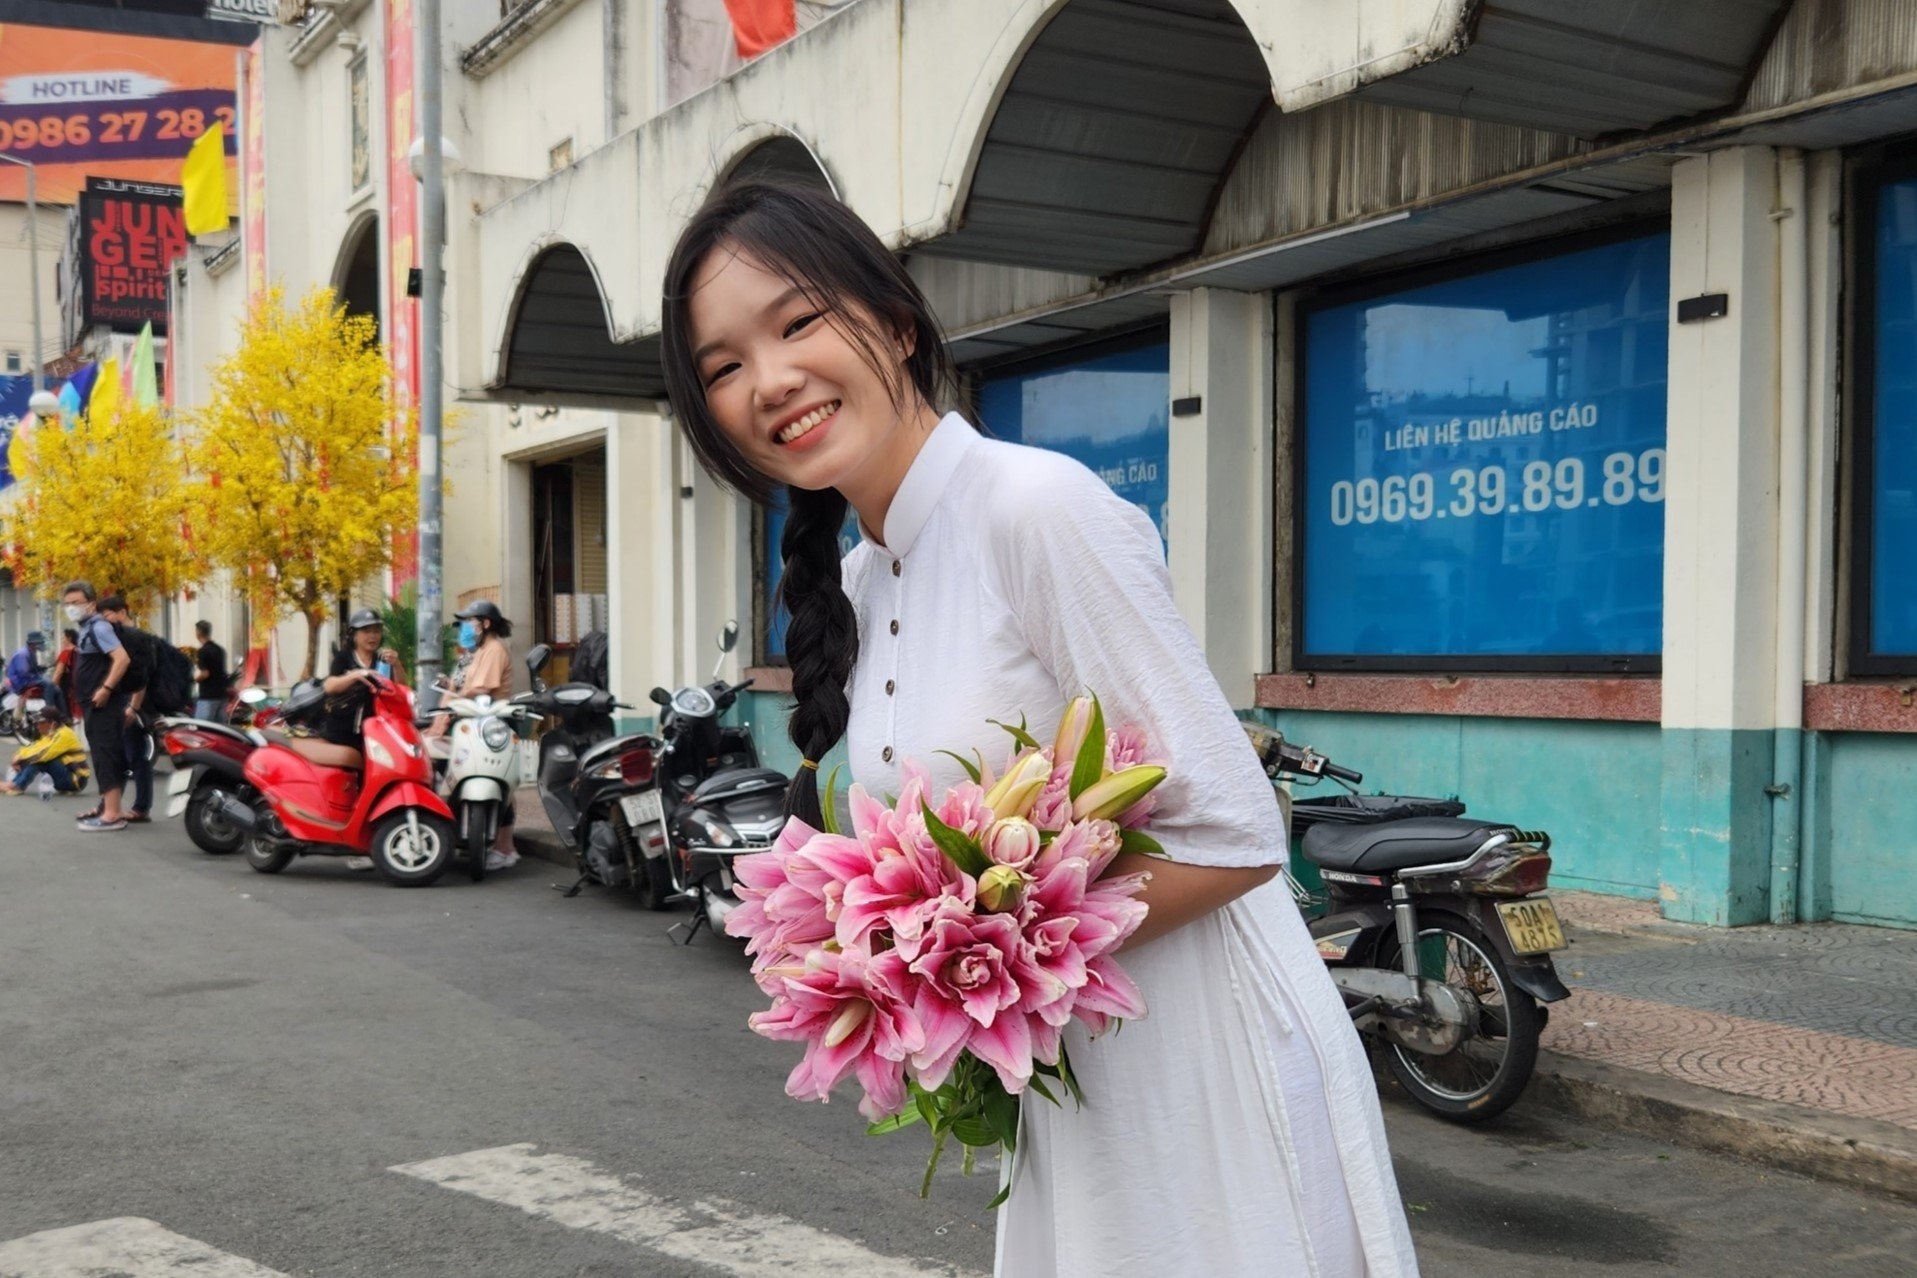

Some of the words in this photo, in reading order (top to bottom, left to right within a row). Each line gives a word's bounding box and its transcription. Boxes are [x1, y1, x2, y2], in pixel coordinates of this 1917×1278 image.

[31, 78, 132, 98] HOTLINE
[98, 110, 148, 144] 27
[156, 107, 206, 140] 28
[92, 303, 140, 319] Beyond
[143, 307, 170, 320] Cre
[1385, 423, 1429, 451] LIÊN
[1434, 417, 1462, 447] HỆ
[1468, 410, 1544, 442] QUẢNG
[1550, 402, 1598, 431] CÁO
[1331, 448, 1666, 527] 0969.39.89.89
[1328, 872, 1357, 883] HONDA
